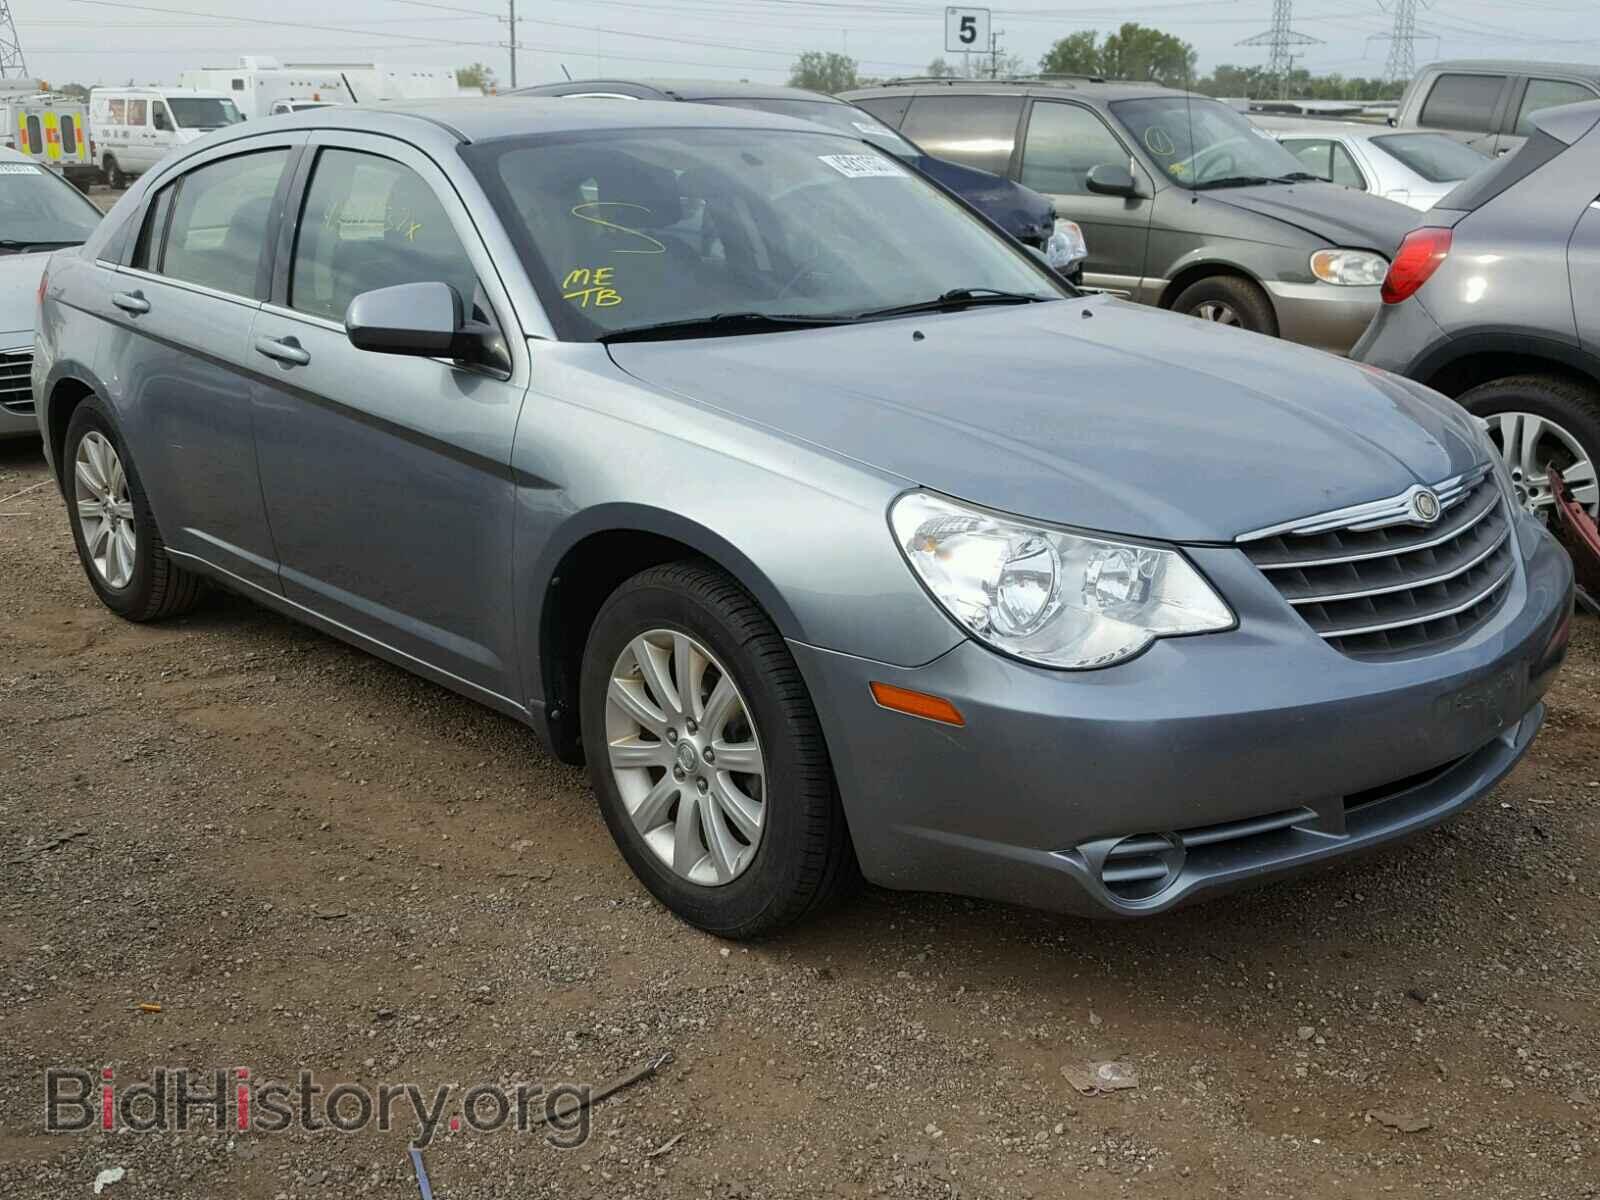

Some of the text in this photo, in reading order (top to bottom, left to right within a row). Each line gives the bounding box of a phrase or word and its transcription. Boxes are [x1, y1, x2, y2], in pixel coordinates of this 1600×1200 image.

[960, 16, 977, 44] 5
[562, 267, 615, 288] ME
[562, 287, 622, 307] TB
